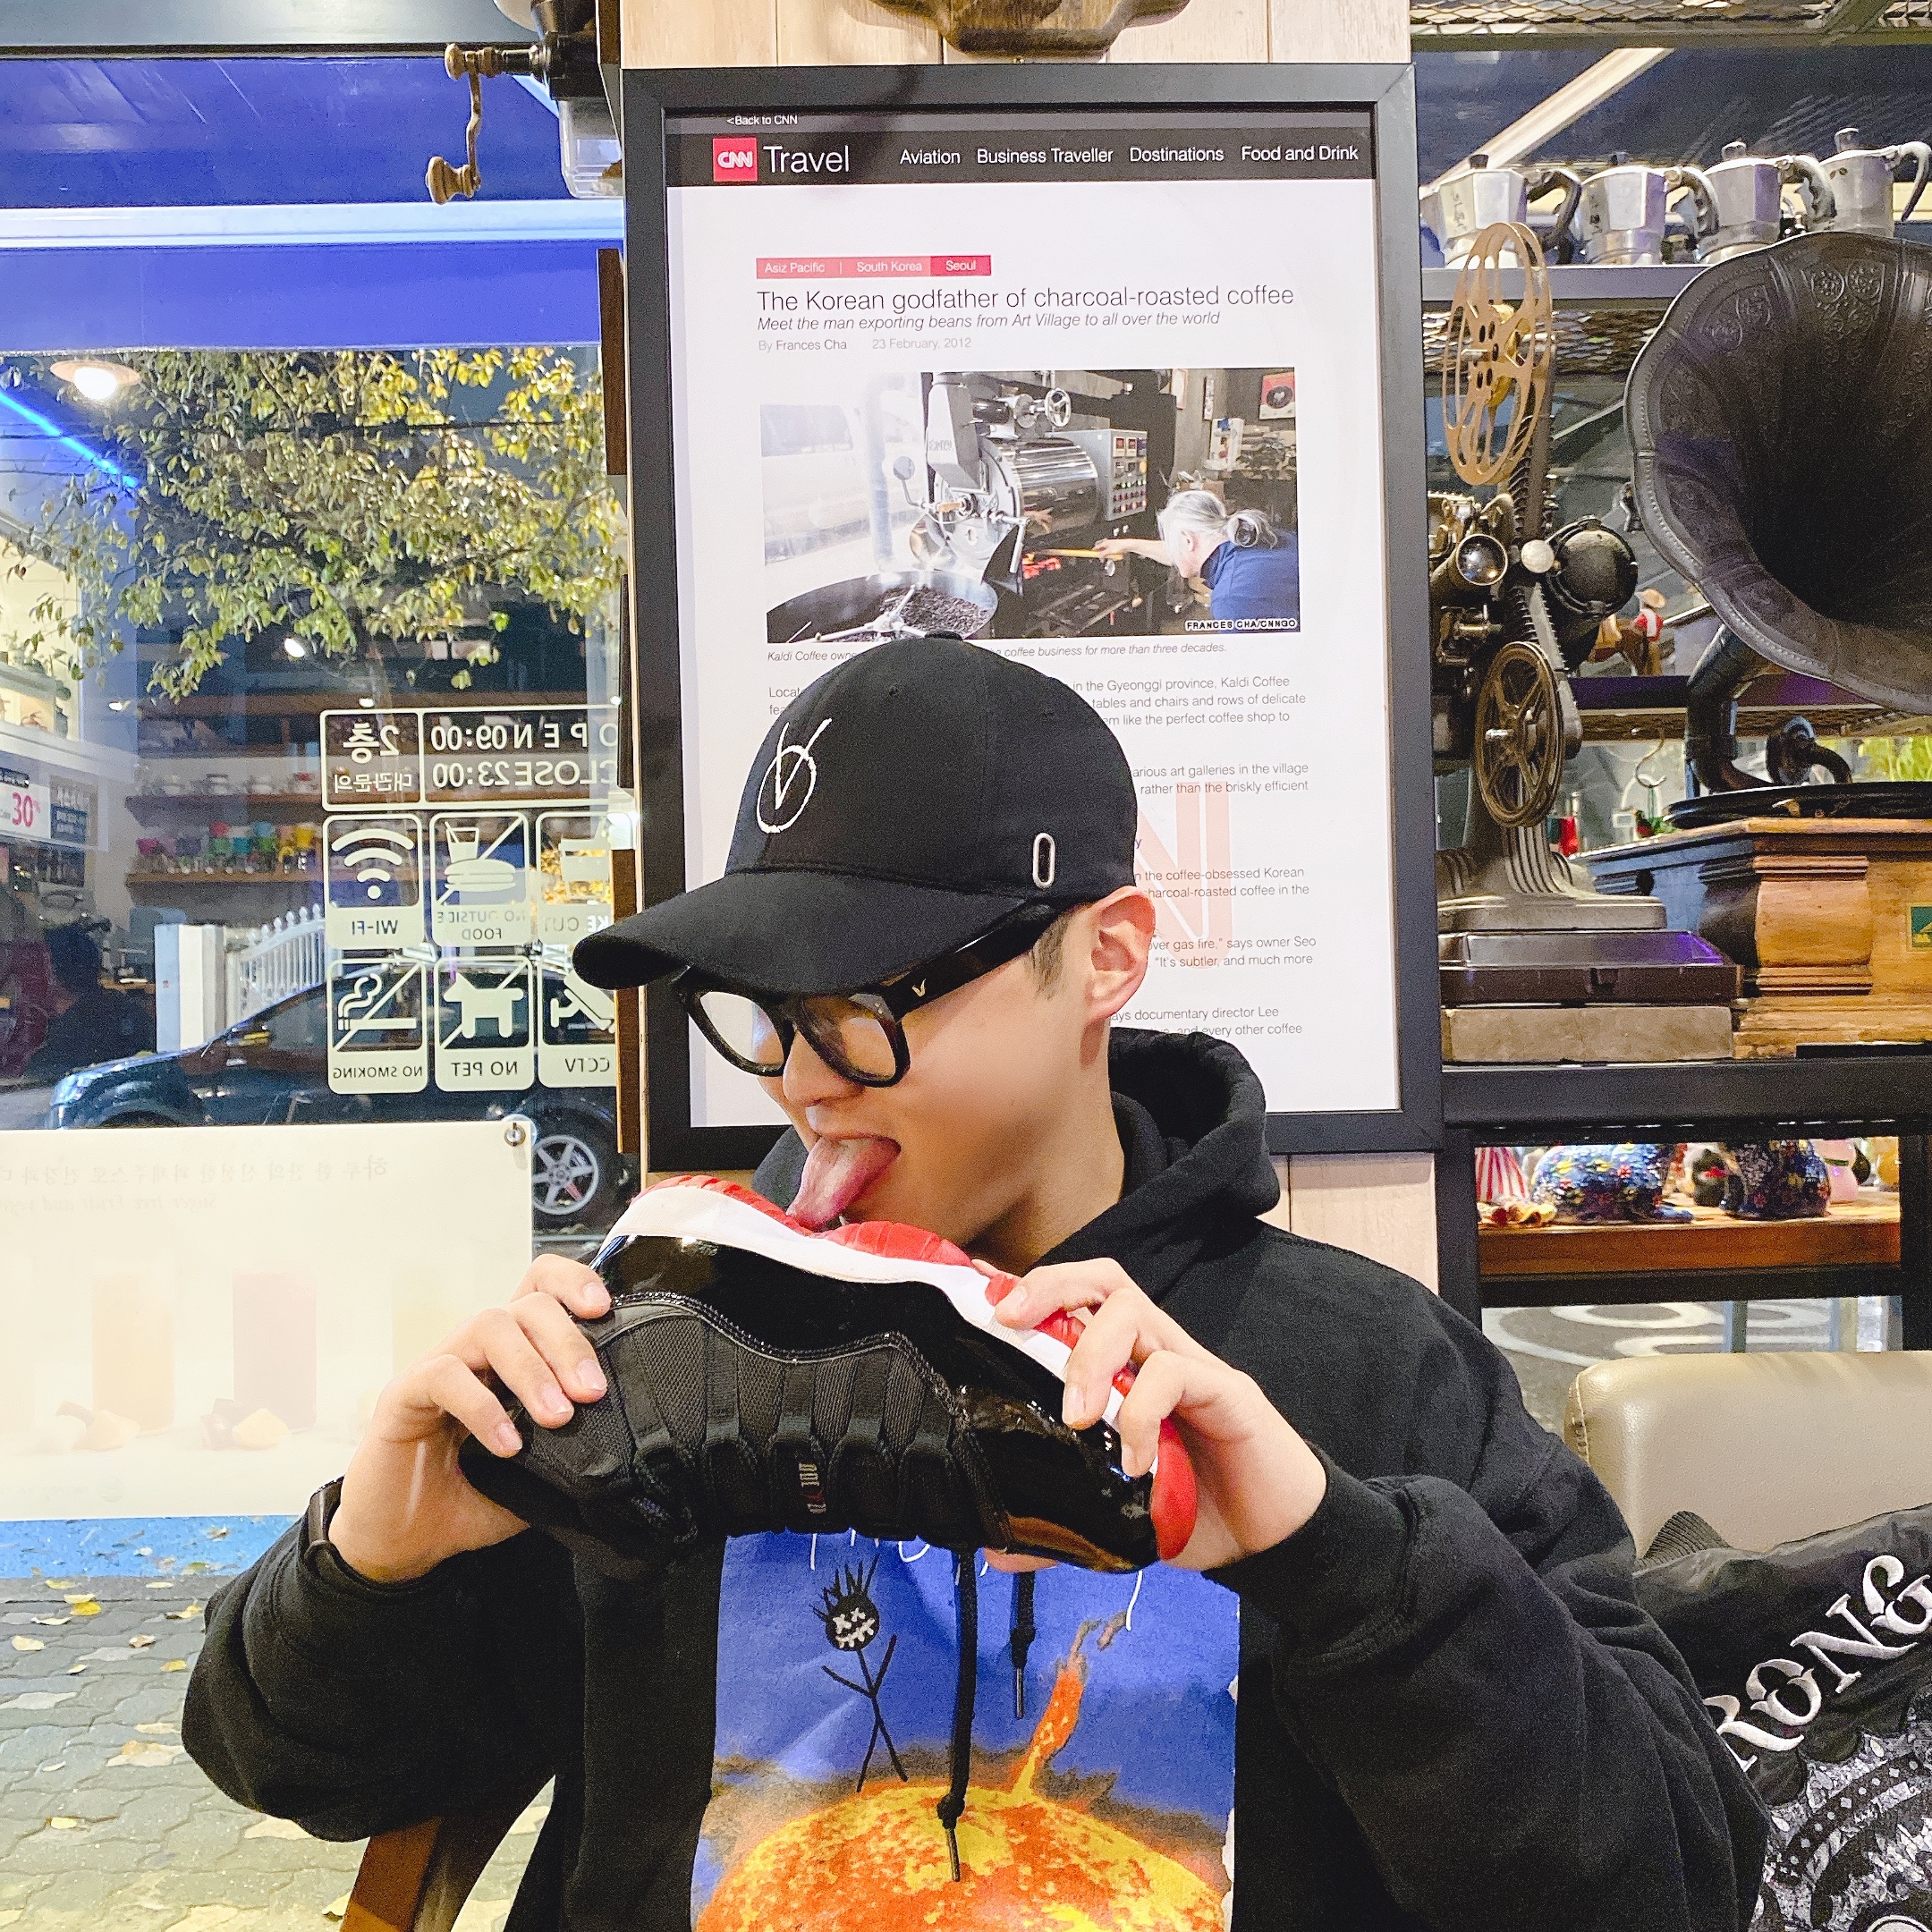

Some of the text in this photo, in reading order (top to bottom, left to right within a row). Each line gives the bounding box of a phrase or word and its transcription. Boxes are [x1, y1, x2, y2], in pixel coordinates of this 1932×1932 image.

[762, 116, 771, 124] to
[775, 115, 797, 124] CNN
[717, 151, 753, 168] CNN
[763, 145, 849, 173] Travel
[900, 148, 960, 164] Aviation
[978, 148, 1114, 163] Business Traveller
[1242, 146, 1358, 160] Food and Drink
[791, 263, 825, 273] Pacific
[857, 261, 922, 272] South Korea
[945, 260, 976, 271] Seoul
[758, 285, 1293, 314] The Korean godfather of charcoal-roasted coffee
[758, 311, 1220, 331] Meet the man exporting beans from Art Village to all over the world
[758, 339, 847, 352] By Frances Cha
[872, 338, 971, 351] 23 February, 2012
[1185, 620, 1233, 631] FRANCES
[767, 651, 792, 661] Kaldi
[795, 650, 827, 661] Coffee
[1004, 648, 1035, 657] coffee
[1086, 646, 1097, 655] for
[1129, 646, 1149, 654] than
[1153, 644, 1177, 653] three
[1181, 642, 1226, 653] decades.
[1073, 676, 1289, 692] in the Gyeonggi province, Kaldi Coffee
[1092, 694, 1306, 708] tables and chairs and rows of delicate
[1123, 715, 1141, 724] like
[1146, 716, 1162, 724] the
[1166, 714, 1205, 724] perfect
[1209, 713, 1243, 723] coffee
[1248, 714, 1275, 723] shop
[1279, 713, 1290, 721] to
[1131, 767, 1166, 777] arious
[1189, 766, 1234, 778] galleries
[1252, 765, 1269, 774] the
[1273, 764, 1308, 775] village
[1140, 781, 1308, 794] rather than the briskly efficient
[1145, 871, 1162, 882] the
[1166, 869, 1259, 881] coffee-obsessed
[1264, 868, 1304, 878] Korean
[1241, 885, 1275, 895] coffee
[1278, 885, 1288, 894] in
[1292, 884, 1309, 894] the
[1173, 941, 1194, 953] gas
[1226, 939, 1253, 951] says
[1257, 938, 1290, 947] owner
[1294, 936, 1316, 946] Seo
[1179, 956, 1220, 968] subtler,
[1223, 954, 1244, 965] and
[1249, 954, 1280, 965] much
[1284, 955, 1313, 963] more
[1109, 1007, 1279, 1023] ays documentary director Lee
[1235, 1024, 1264, 1035] other
[1267, 1023, 1302, 1034] coffee
